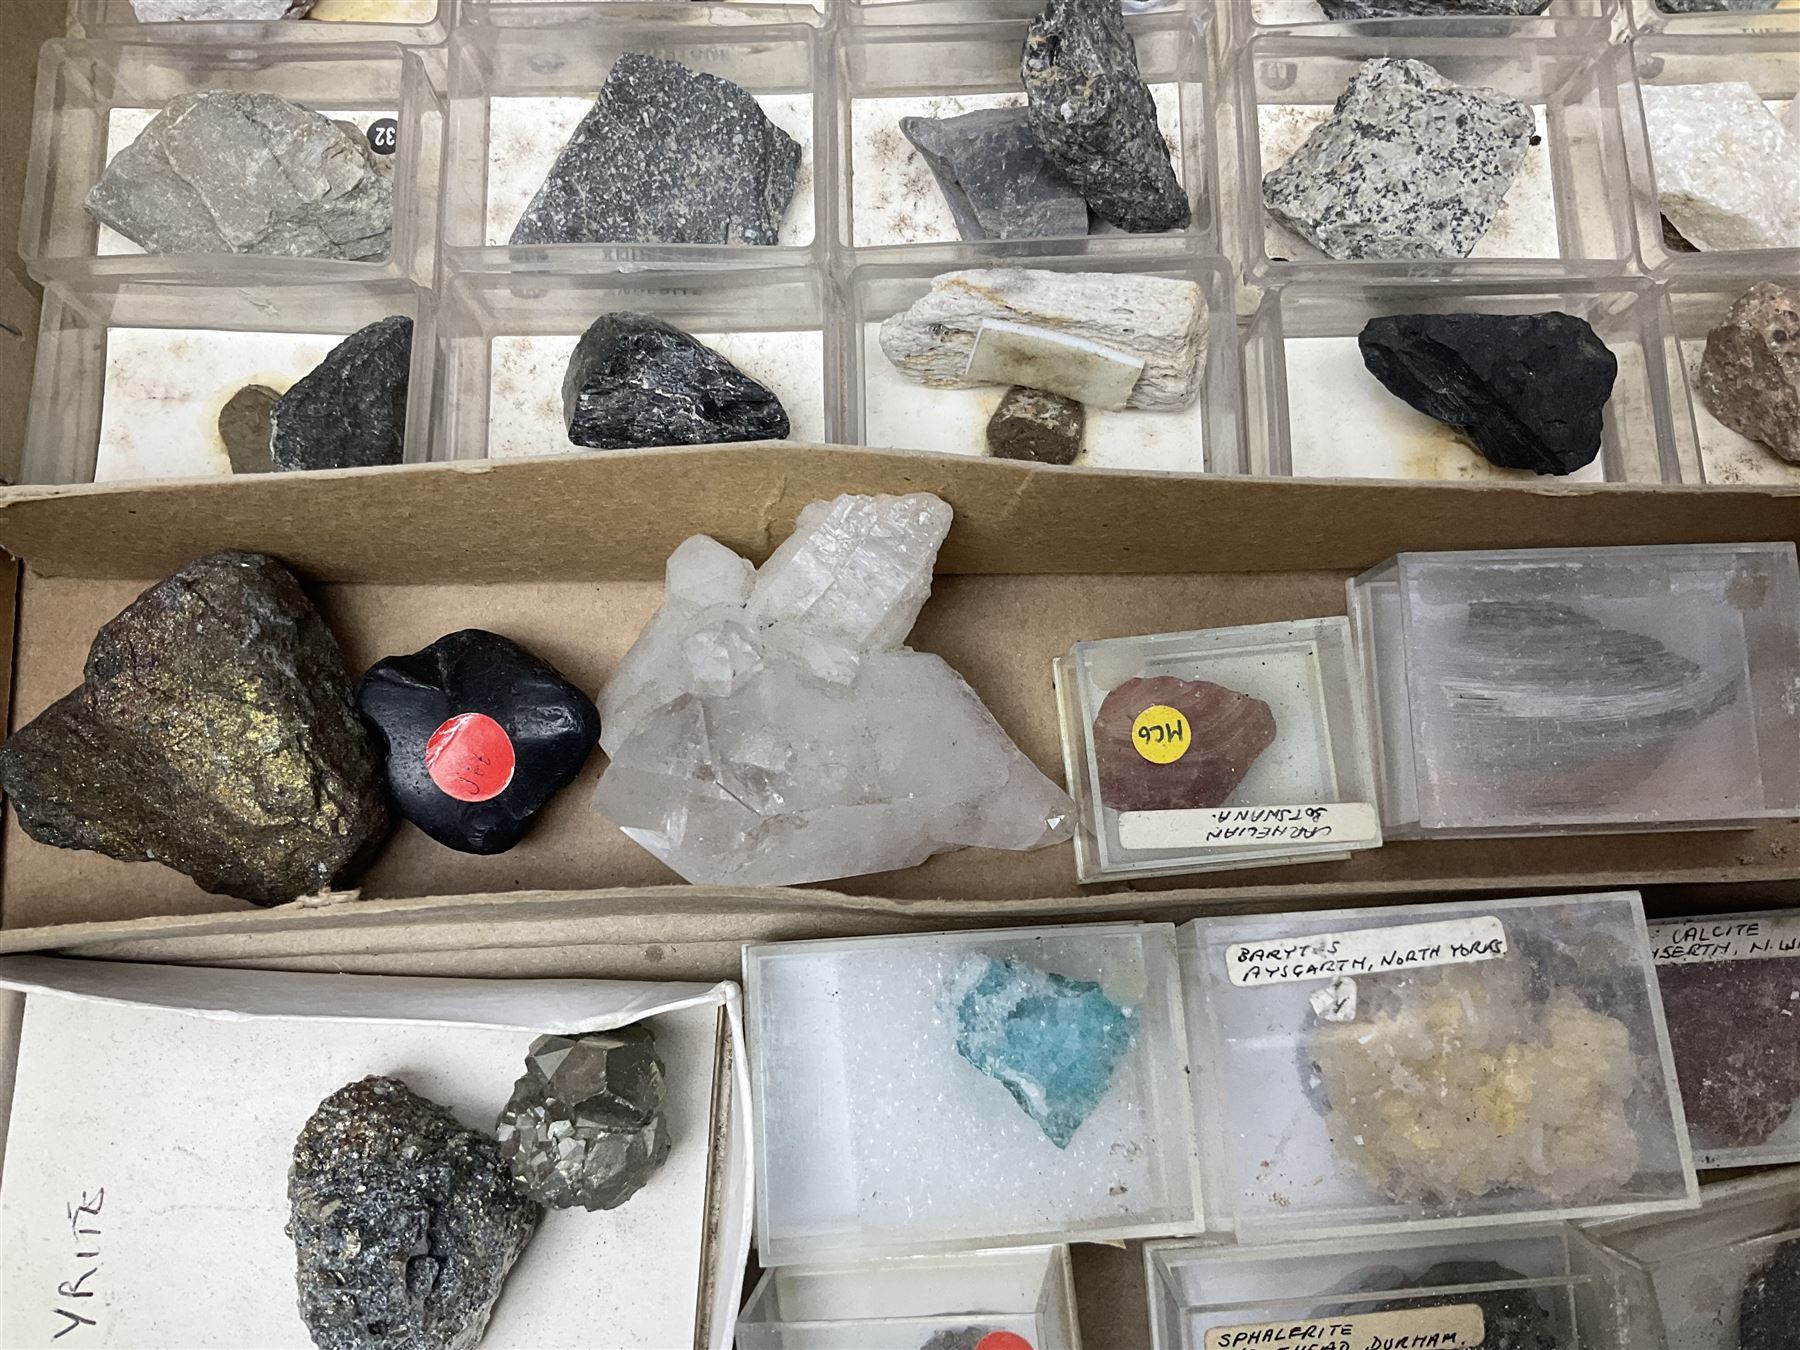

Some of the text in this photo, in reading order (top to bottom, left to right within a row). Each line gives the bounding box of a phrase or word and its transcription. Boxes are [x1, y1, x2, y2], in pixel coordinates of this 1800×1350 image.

[374, 126, 396, 146] 32
[1137, 719, 1183, 744] MC6
[1672, 922, 1760, 945] CALCITE
[1380, 944, 1441, 967] NORTH
[1217, 1323, 1355, 1348] SPHALERITE
